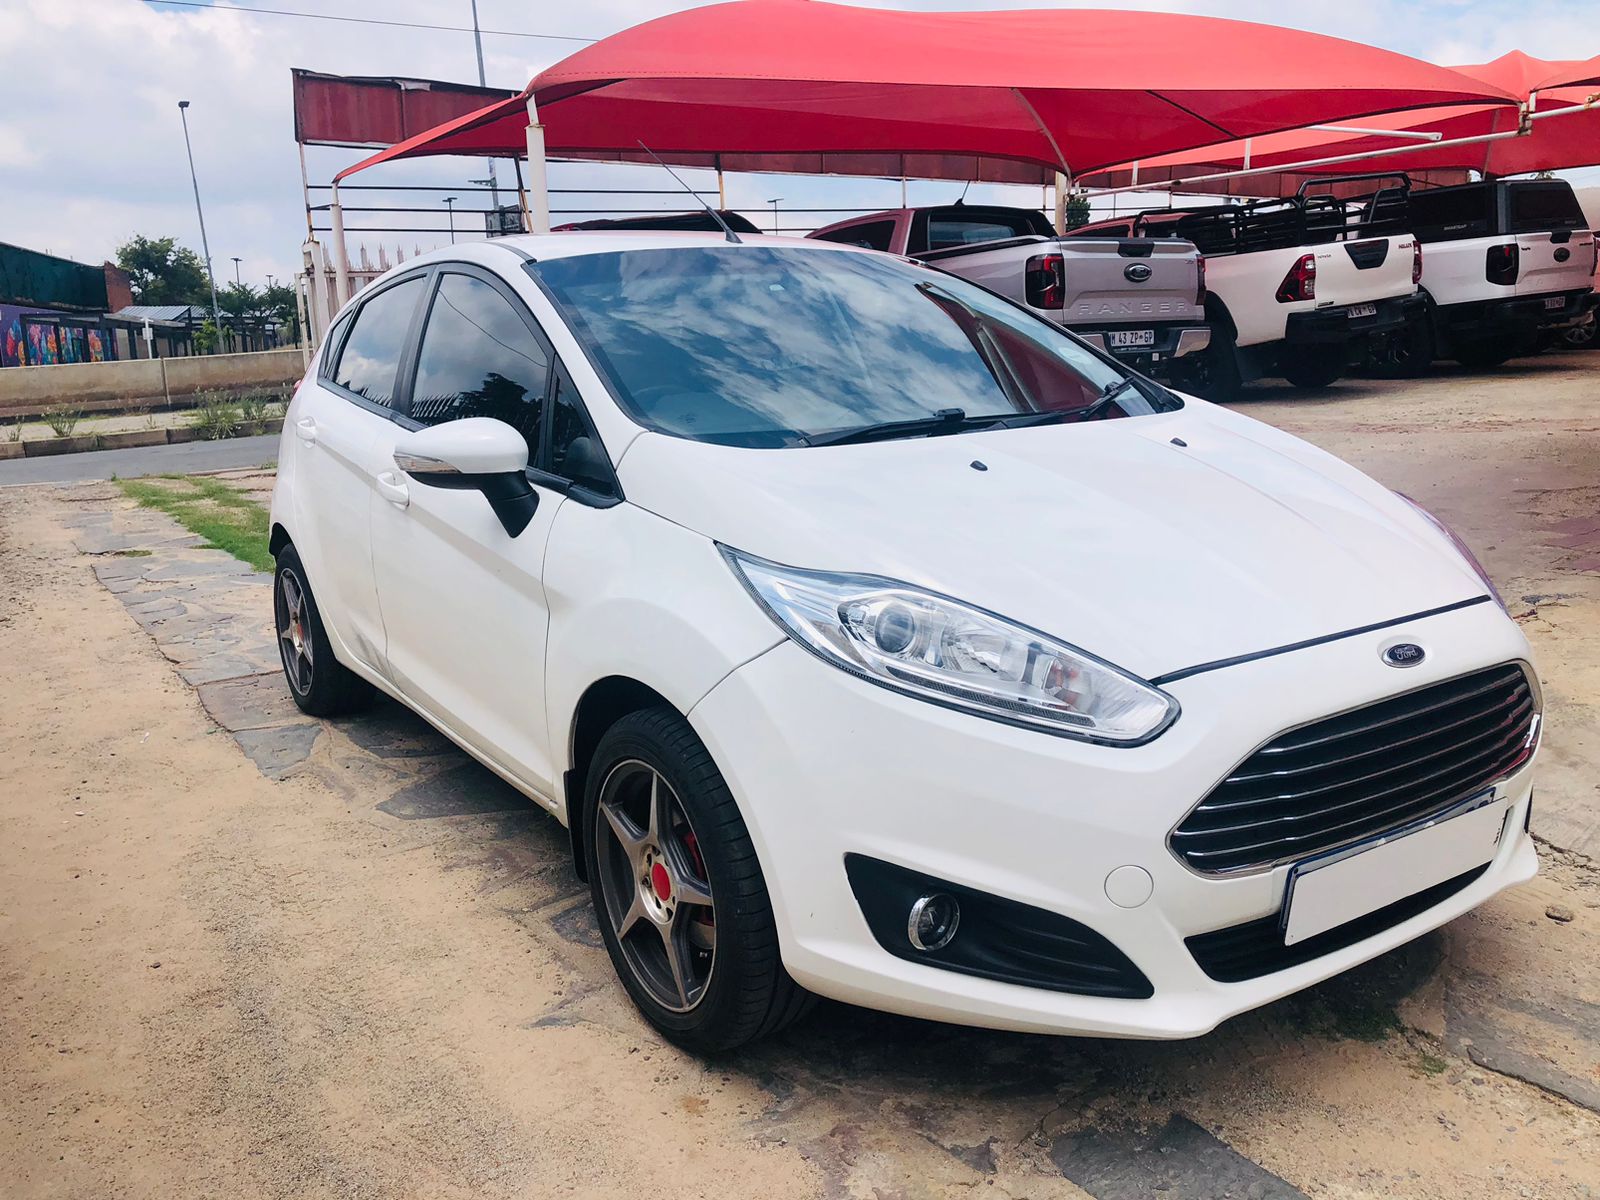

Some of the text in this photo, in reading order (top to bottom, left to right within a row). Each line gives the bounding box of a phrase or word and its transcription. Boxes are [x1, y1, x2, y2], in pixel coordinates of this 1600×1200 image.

[1078, 302, 1188, 314] RANGER
[1118, 332, 1127, 345] 43
[1130, 332, 1138, 344] ZP
[1144, 331, 1153, 343] GP
[1394, 646, 1418, 660] Ford
